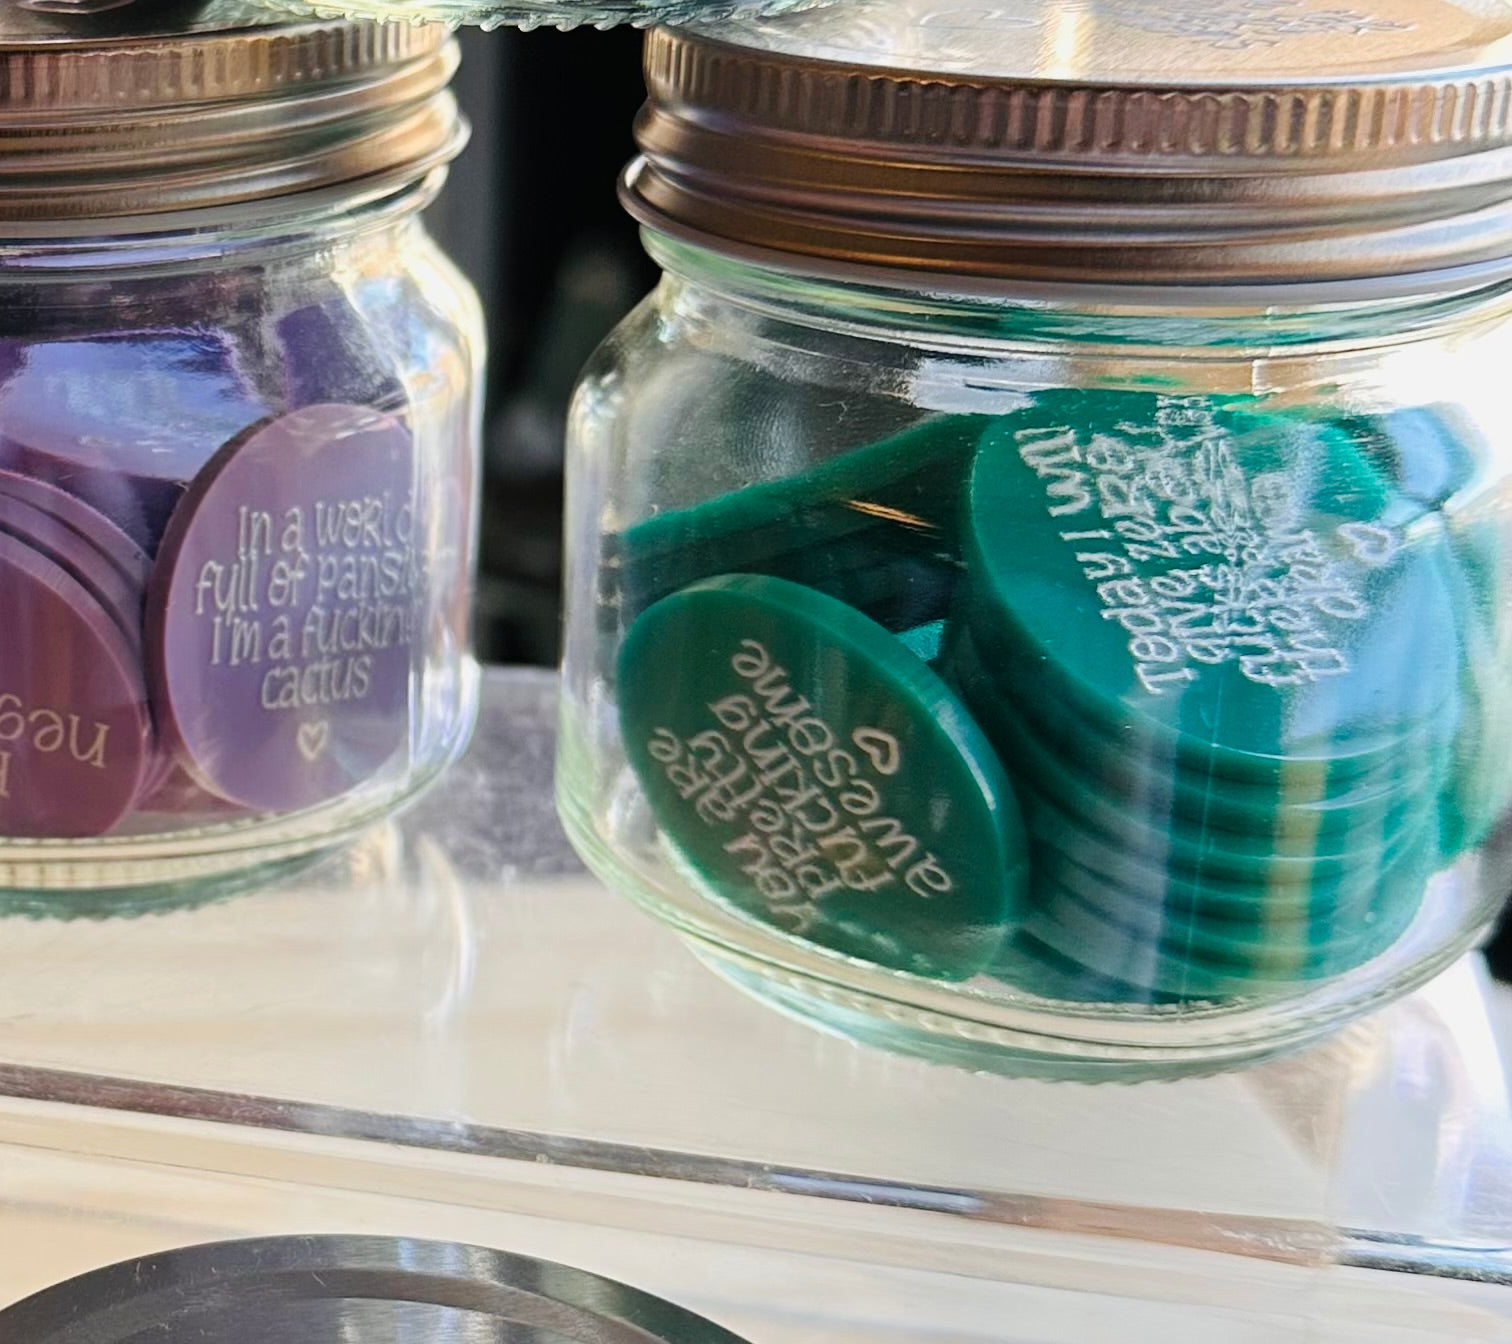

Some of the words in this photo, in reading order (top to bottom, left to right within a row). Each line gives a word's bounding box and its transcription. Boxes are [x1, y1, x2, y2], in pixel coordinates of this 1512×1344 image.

[237, 505, 272, 555] In
[280, 506, 305, 553] a
[194, 549, 260, 616] full
[268, 553, 311, 607] of
[268, 614, 292, 661] a
[260, 654, 372, 710] cactus
[707, 694, 895, 892] fucking
[731, 638, 953, 899] awesome
